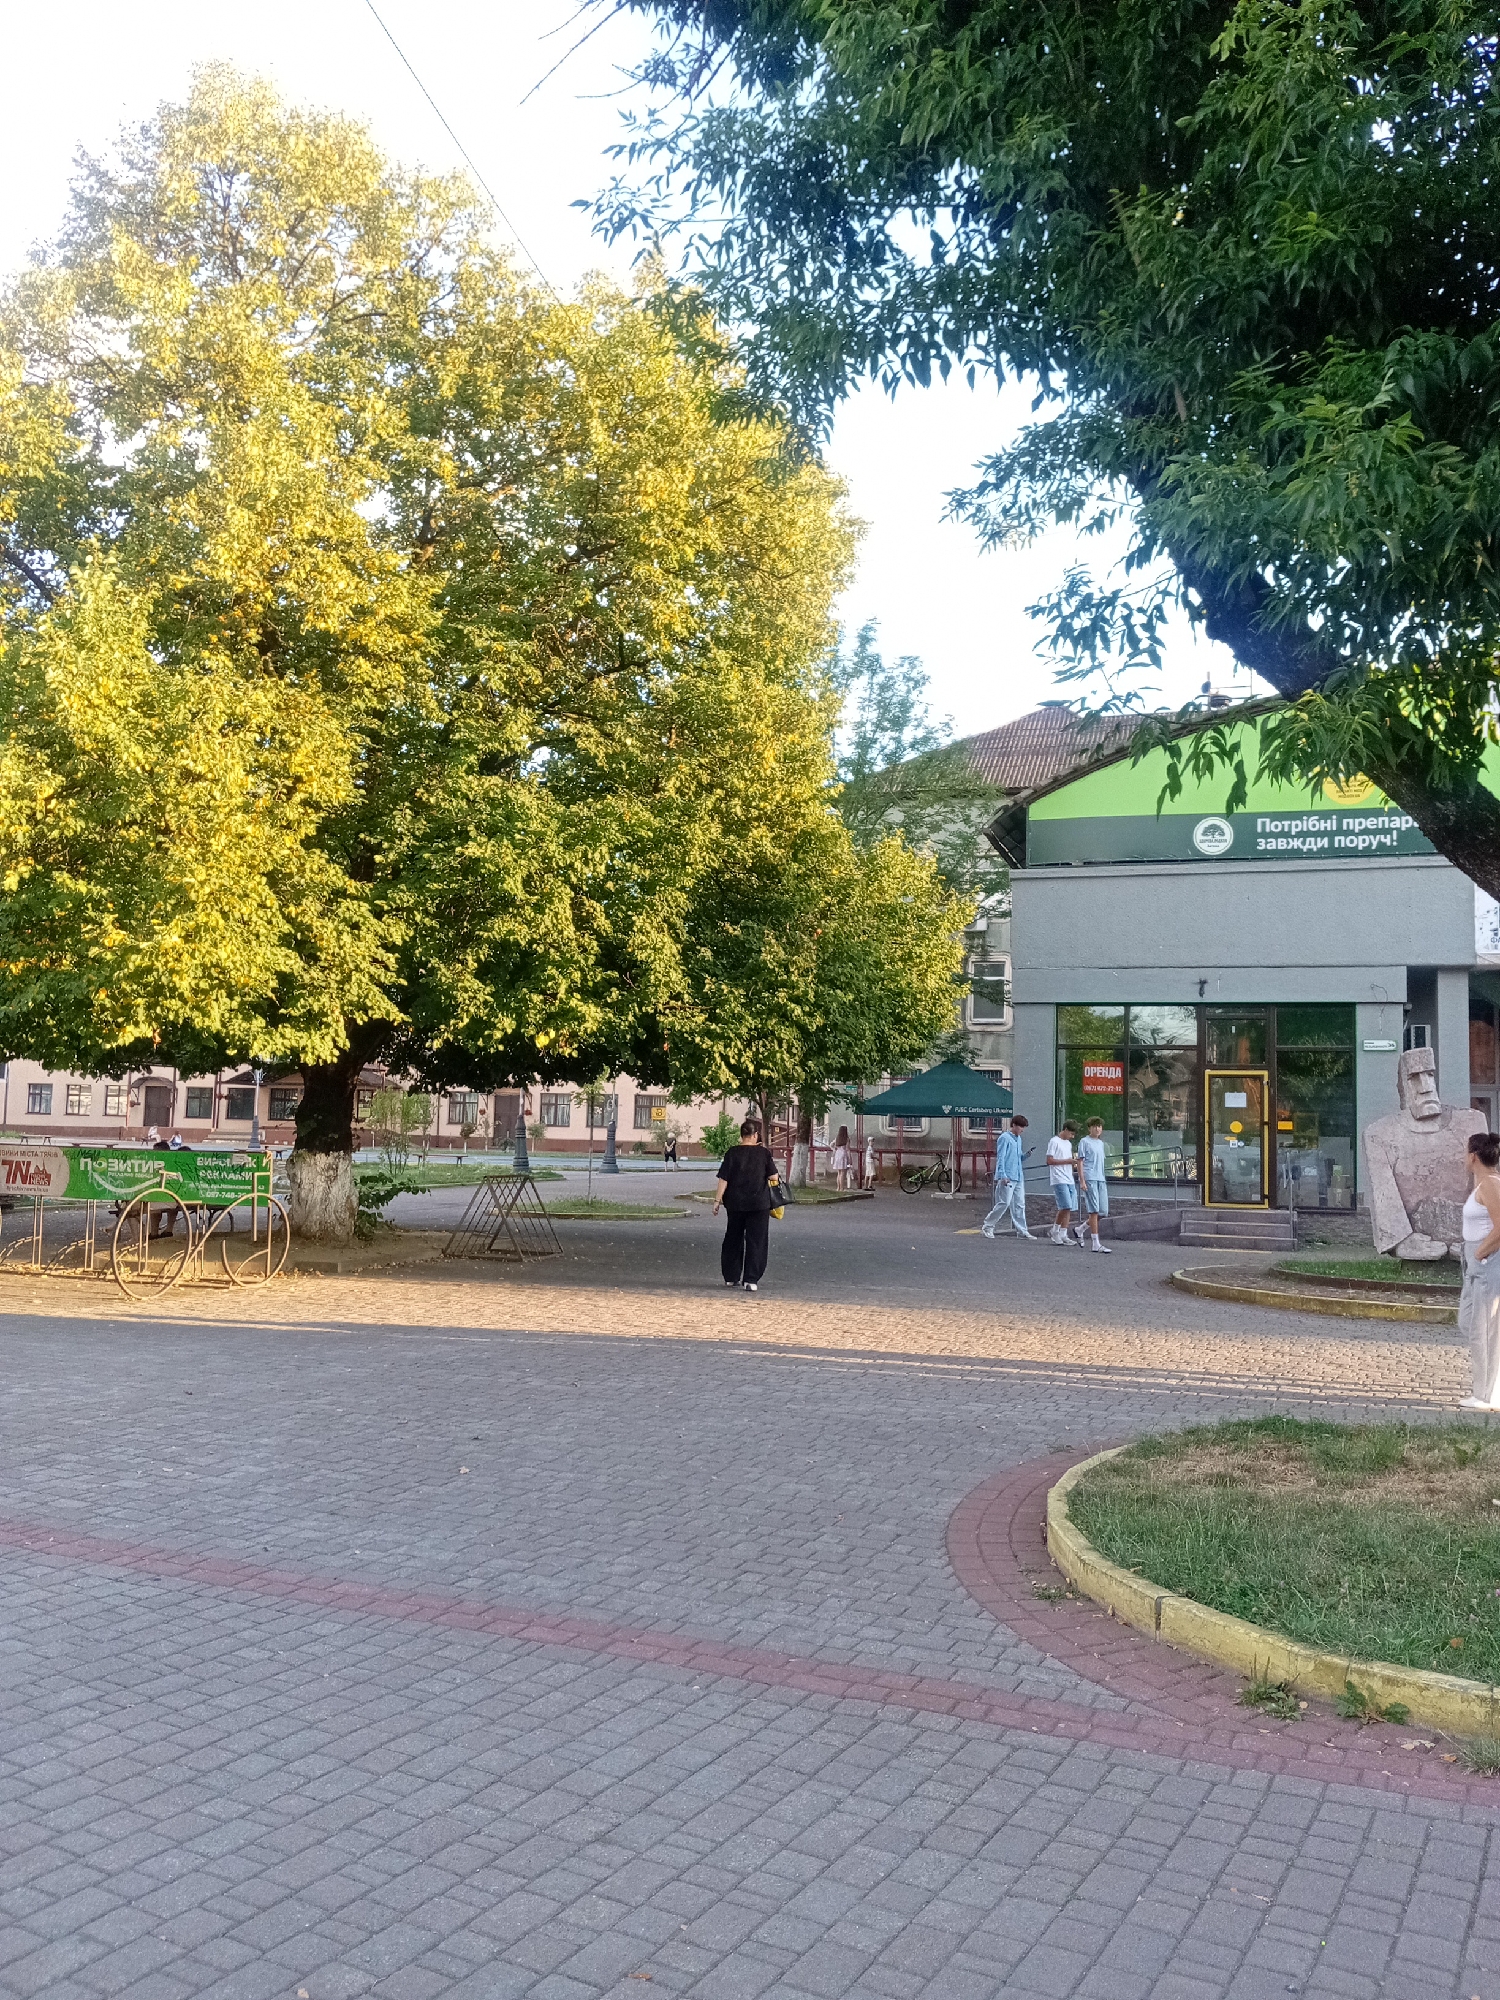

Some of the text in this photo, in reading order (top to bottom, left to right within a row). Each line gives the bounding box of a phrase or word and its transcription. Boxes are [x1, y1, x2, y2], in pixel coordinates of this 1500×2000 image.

[1256, 815, 1337, 835] Потрібні
[1256, 830, 1398, 852] завжди поруч!
[1084, 1066, 1122, 1079] ОРЕНДА
